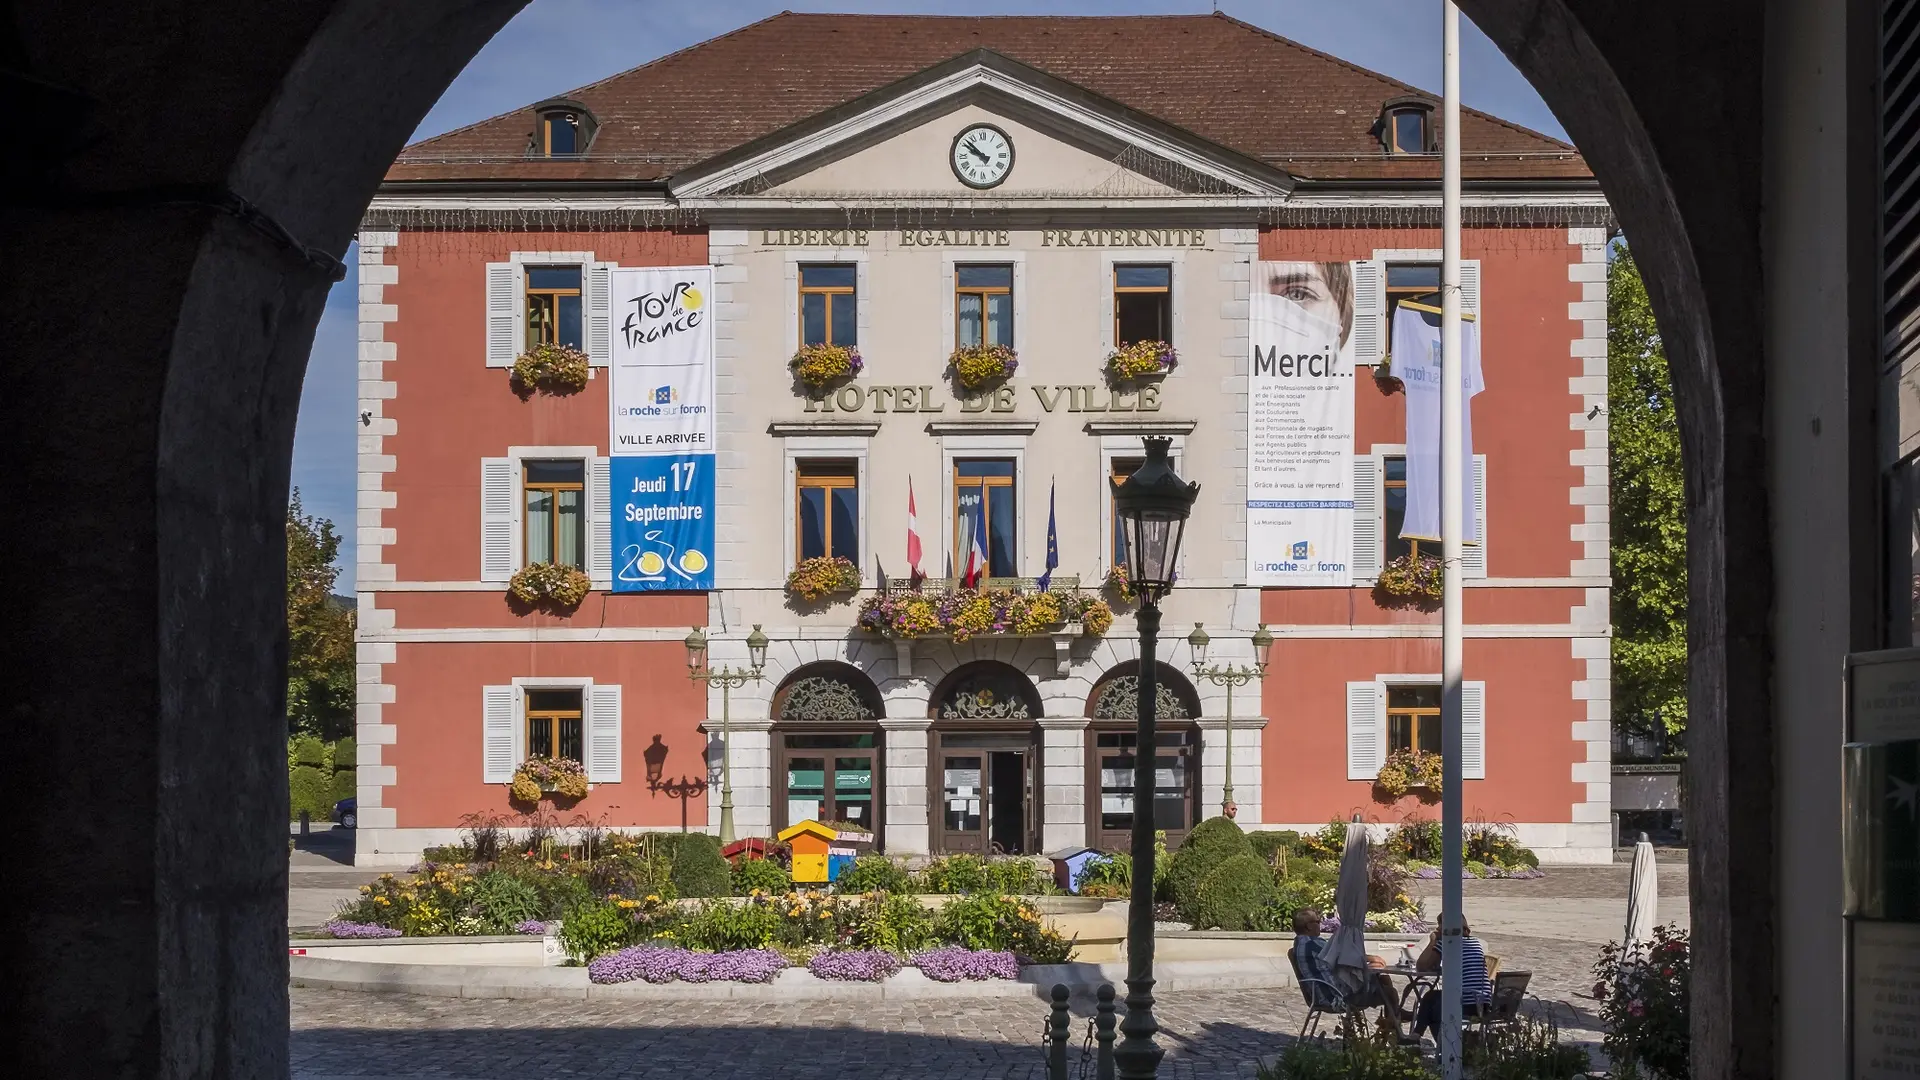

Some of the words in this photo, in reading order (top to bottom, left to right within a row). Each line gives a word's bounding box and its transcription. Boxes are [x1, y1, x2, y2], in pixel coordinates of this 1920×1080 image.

[761, 229, 869, 246] LIBERTE
[899, 229, 1010, 246] EGALITE
[1041, 229, 1206, 247] FRATERNITE
[672, 305, 684, 317] de
[1030, 384, 1163, 413] VILLE
[618, 406, 627, 415] la
[630, 406, 661, 415] roche
[663, 407, 678, 415] sur
[680, 404, 706, 414] foron
[619, 435, 653, 445] VILLE
[631, 476, 666, 493] Jeudi
[670, 462, 696, 492] 17
[625, 502, 703, 526] Septembre
[1254, 561, 1263, 571] la
[1266, 561, 1298, 571] roche
[1300, 563, 1315, 571] sur
[1317, 561, 1345, 571] foron
